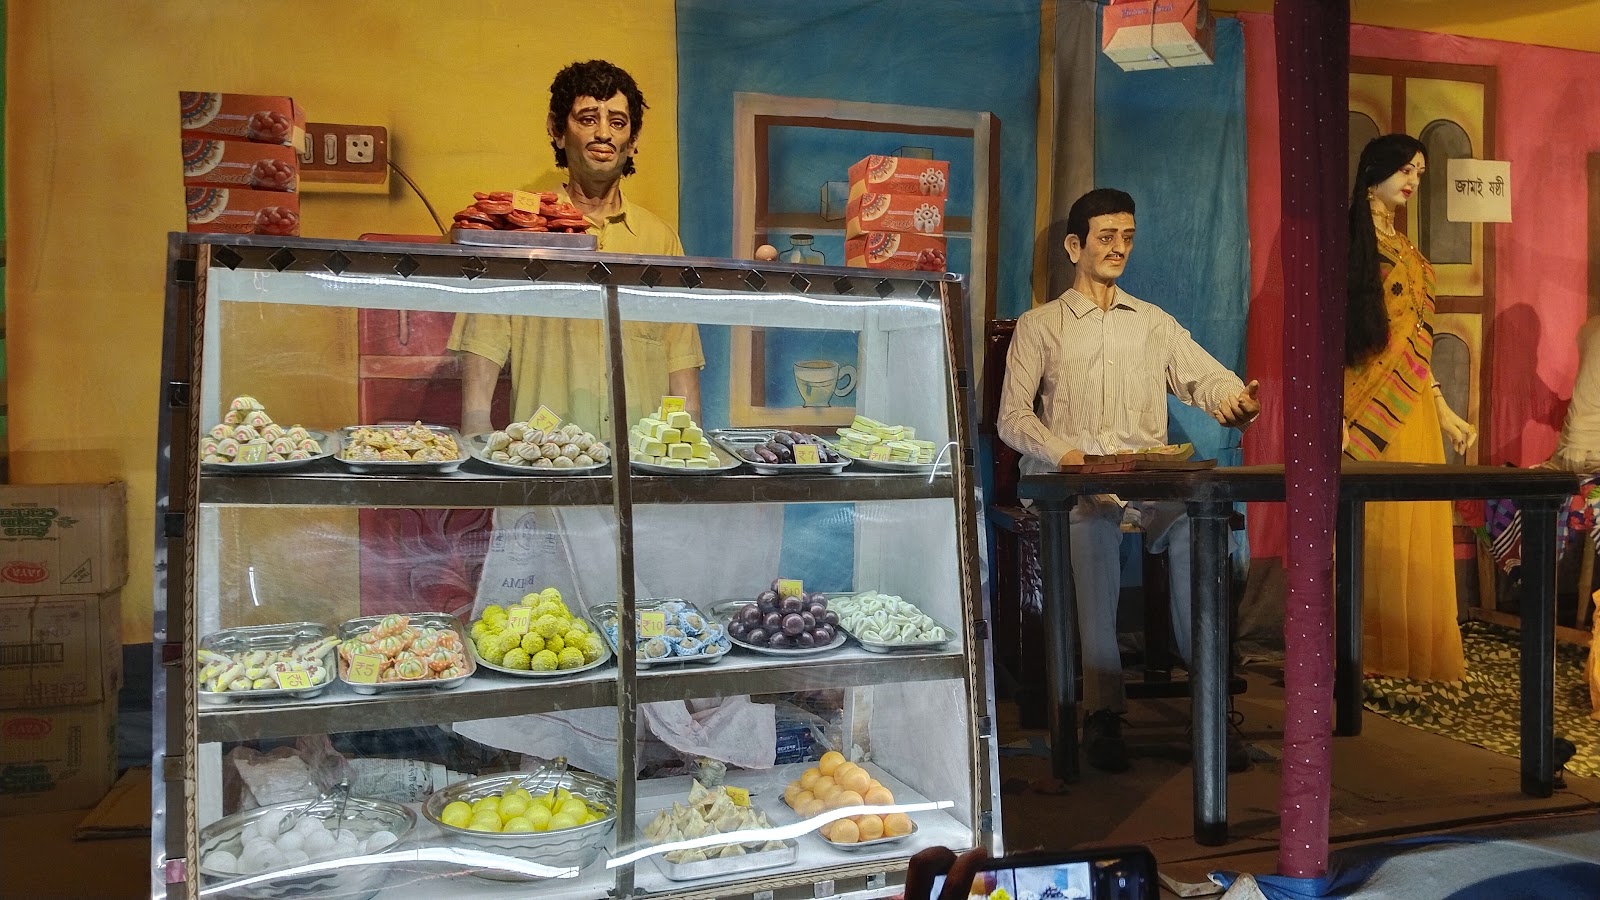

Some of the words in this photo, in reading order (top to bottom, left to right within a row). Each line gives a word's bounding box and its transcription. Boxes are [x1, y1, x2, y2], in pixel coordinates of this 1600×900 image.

[1454, 176, 1485, 199] জামাই
[518, 195, 535, 207] ₹5
[536, 413, 554, 431] ₹7
[798, 450, 815, 462] ₹7
[510, 616, 527, 629] ₹10
[642, 619, 663, 632] ₹10
[354, 661, 374, 677] ₹5
[286, 674, 304, 687] ₹5
[730, 791, 746, 803] ₹5
